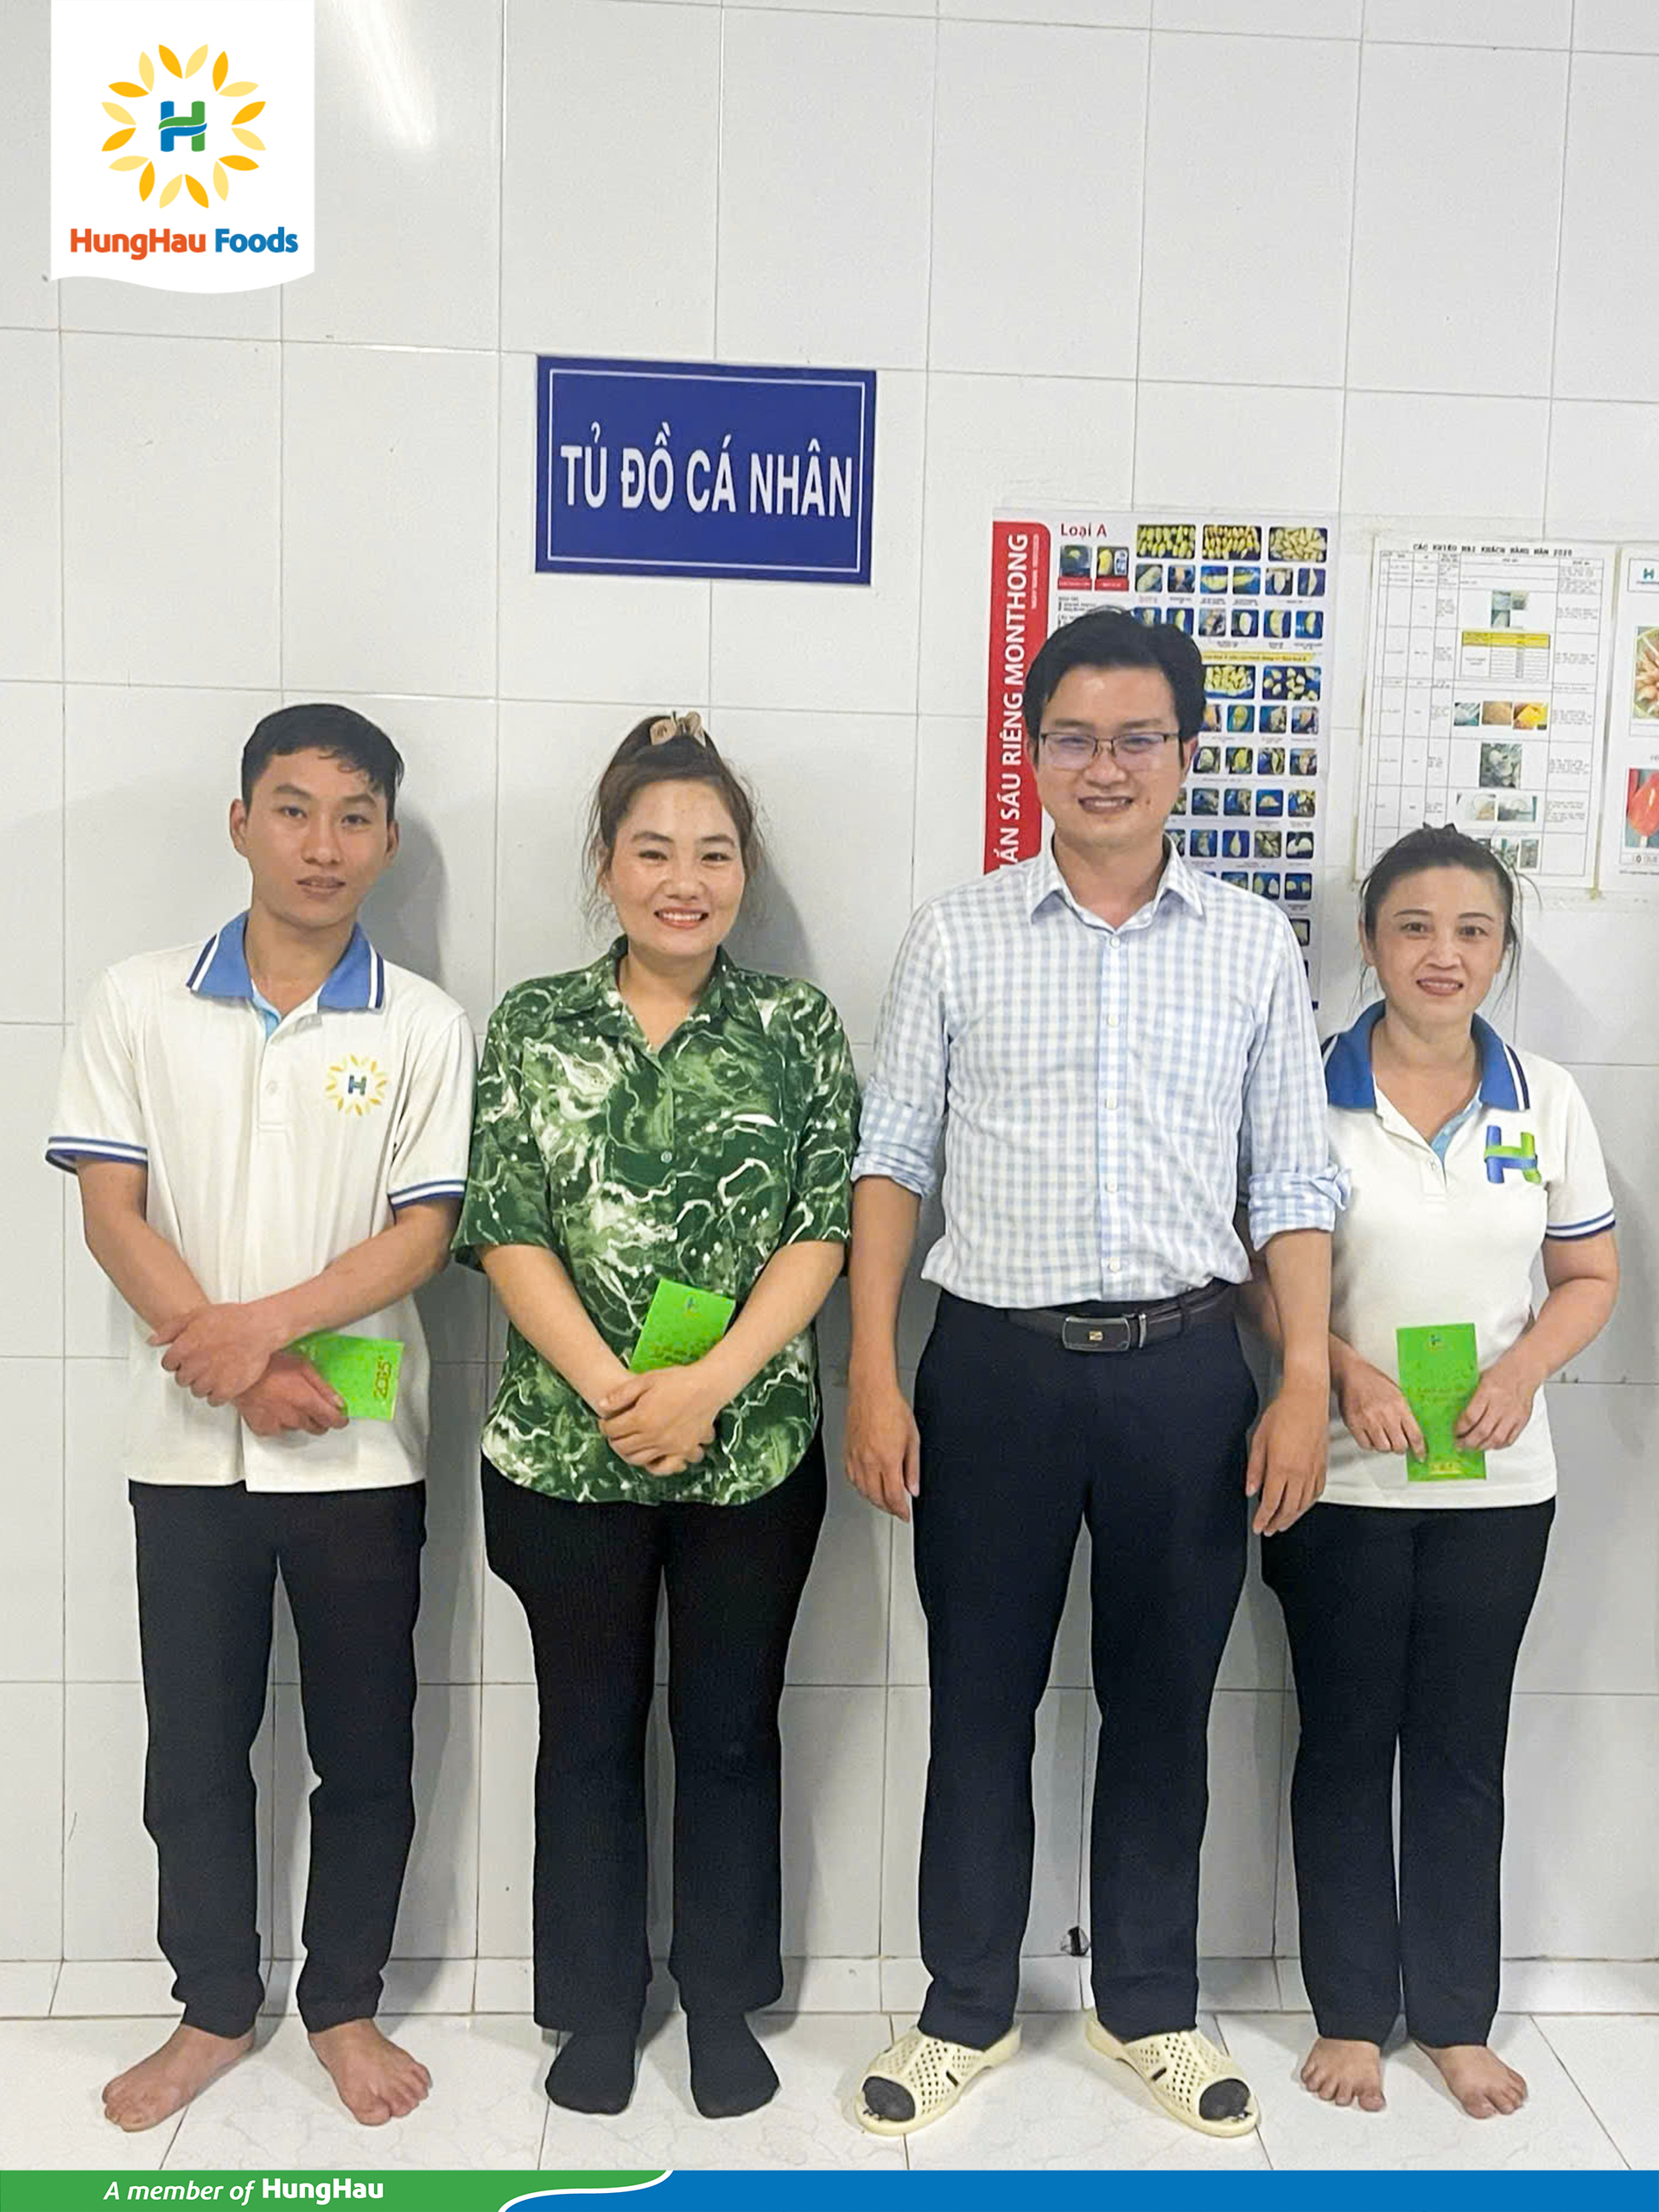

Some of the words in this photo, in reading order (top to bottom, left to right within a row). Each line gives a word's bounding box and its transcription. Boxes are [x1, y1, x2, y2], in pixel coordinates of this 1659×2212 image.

[560, 421, 607, 509] TỦ
[620, 421, 675, 512] ĐỒ
[686, 434, 736, 512] CÁ
[749, 438, 853, 518] NHÂN
[1096, 523, 1108, 537] A
[1004, 533, 1028, 685] MONTHONG
[999, 692, 1023, 766] RIÊNG
